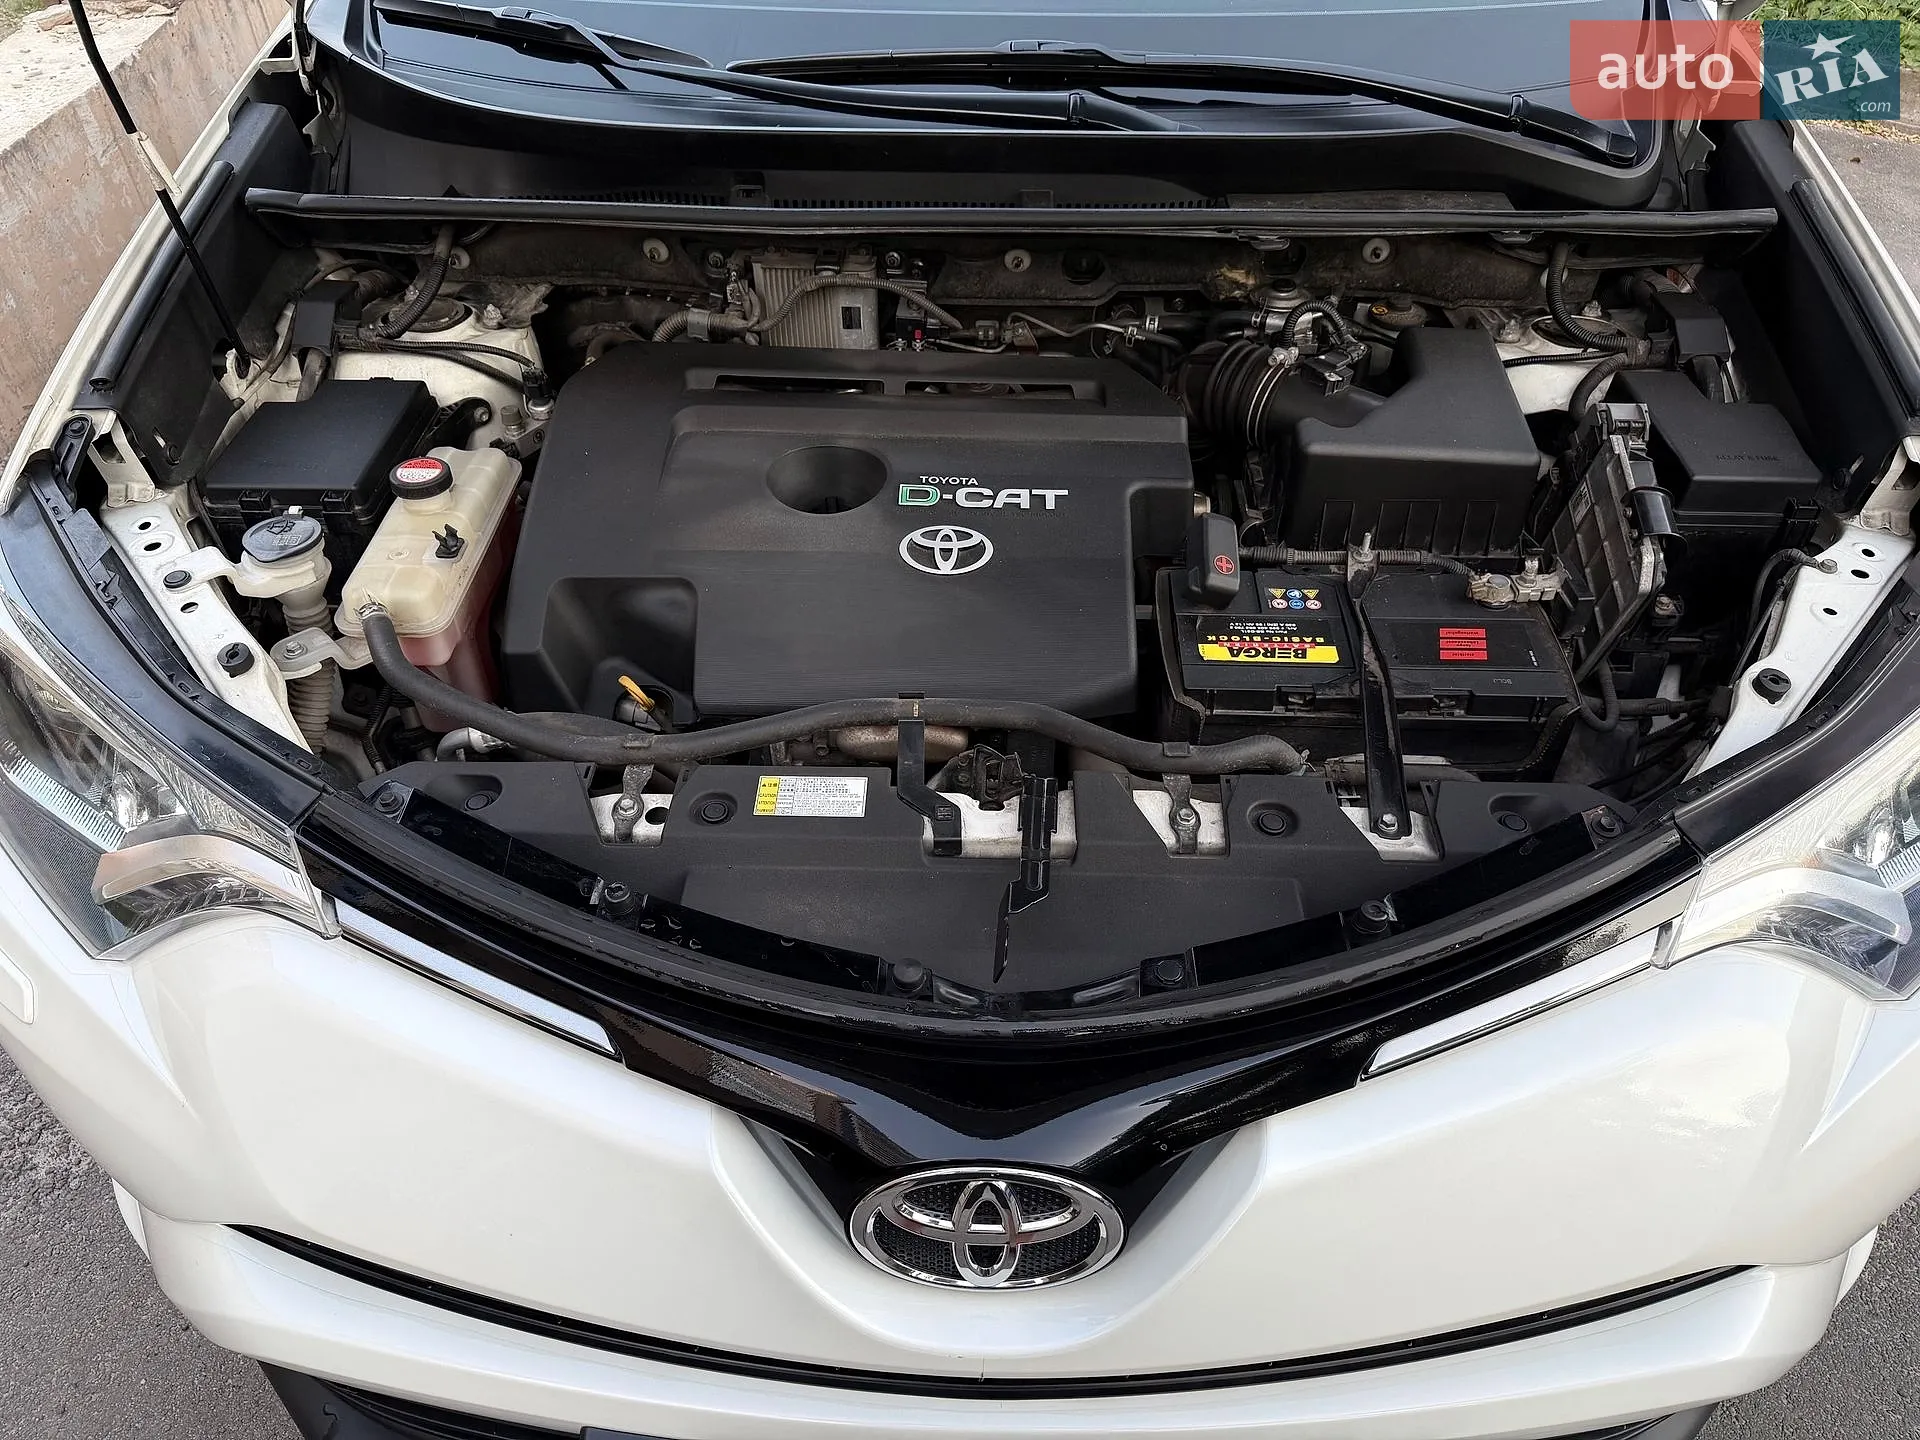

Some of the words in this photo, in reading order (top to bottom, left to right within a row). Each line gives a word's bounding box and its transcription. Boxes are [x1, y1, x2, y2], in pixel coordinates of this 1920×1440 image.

[919, 475, 979, 486] TOYOTA
[898, 484, 1069, 510] D-CAT
[1206, 635, 1325, 643] BASIC-BLOCK
[1226, 647, 1308, 659] BERGA
